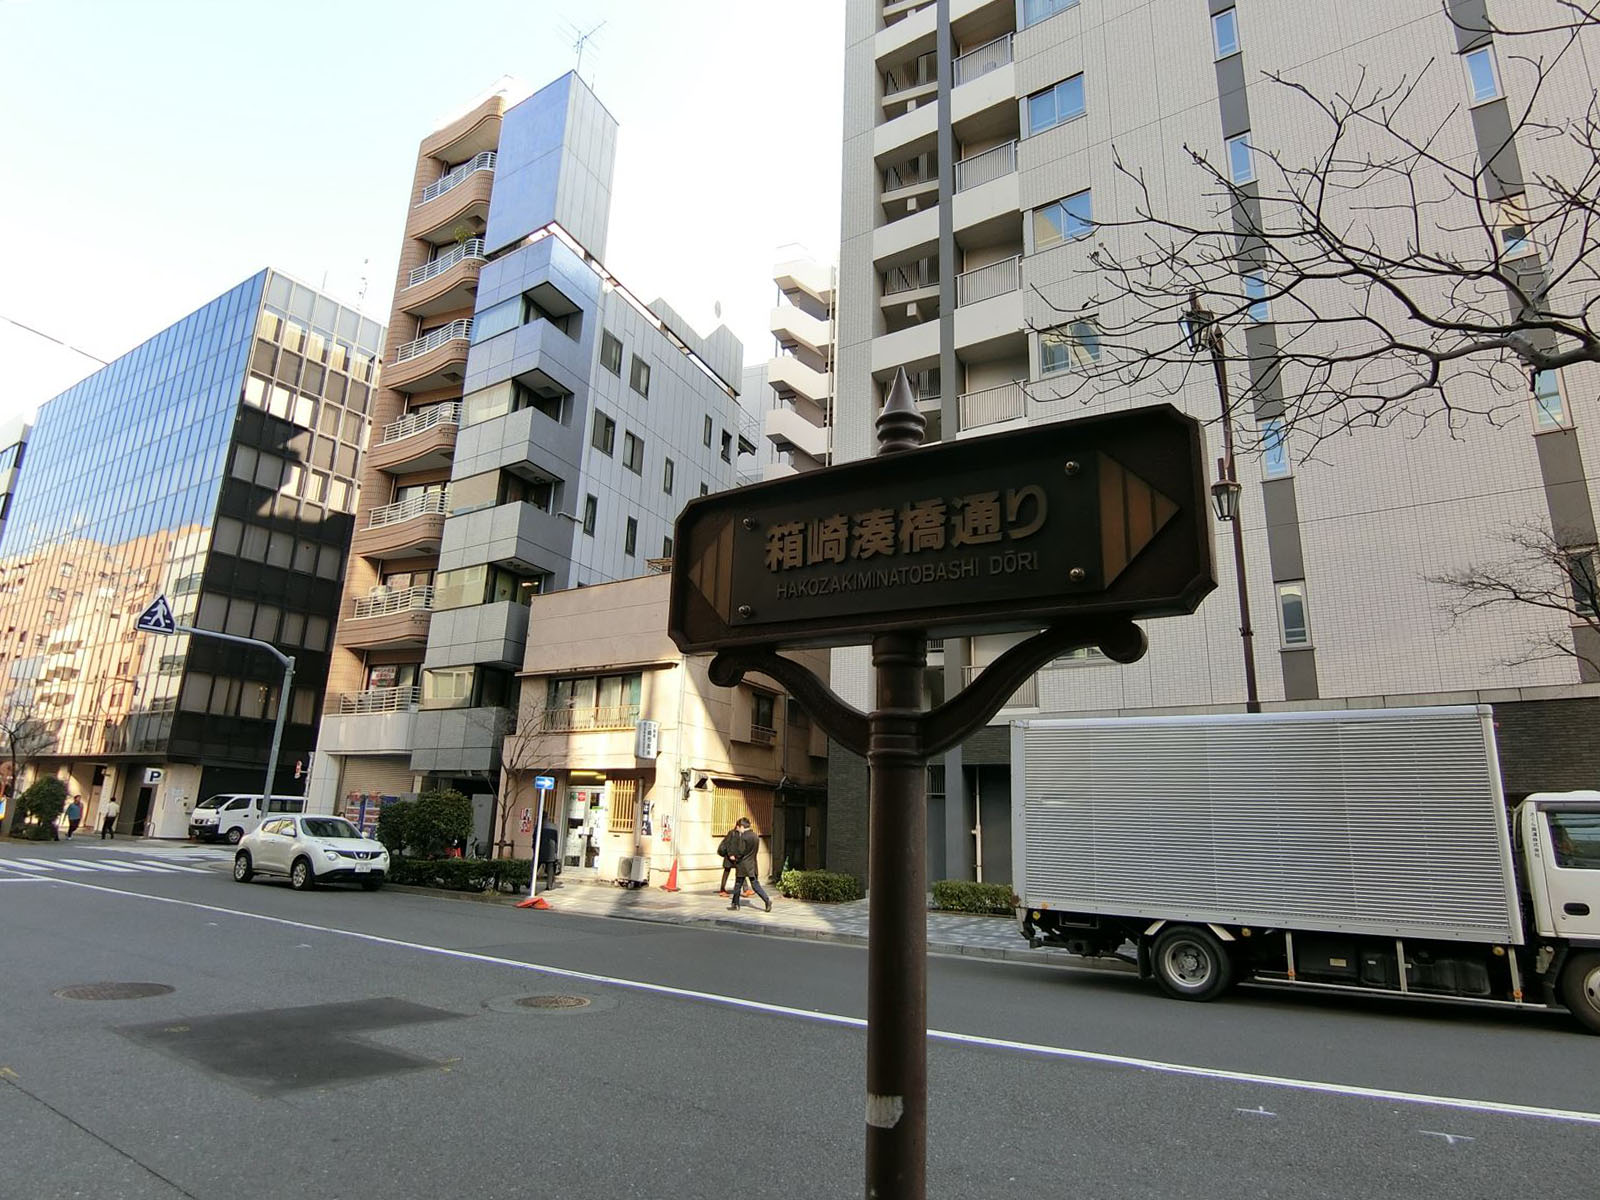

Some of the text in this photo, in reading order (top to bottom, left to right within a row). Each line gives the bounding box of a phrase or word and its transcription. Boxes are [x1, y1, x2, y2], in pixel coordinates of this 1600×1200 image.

[764, 484, 1048, 573] 箱崎湊橋通り
[775, 558, 980, 600] HAKOZAKIMINATOBASHI
[149, 770, 162, 782] P
